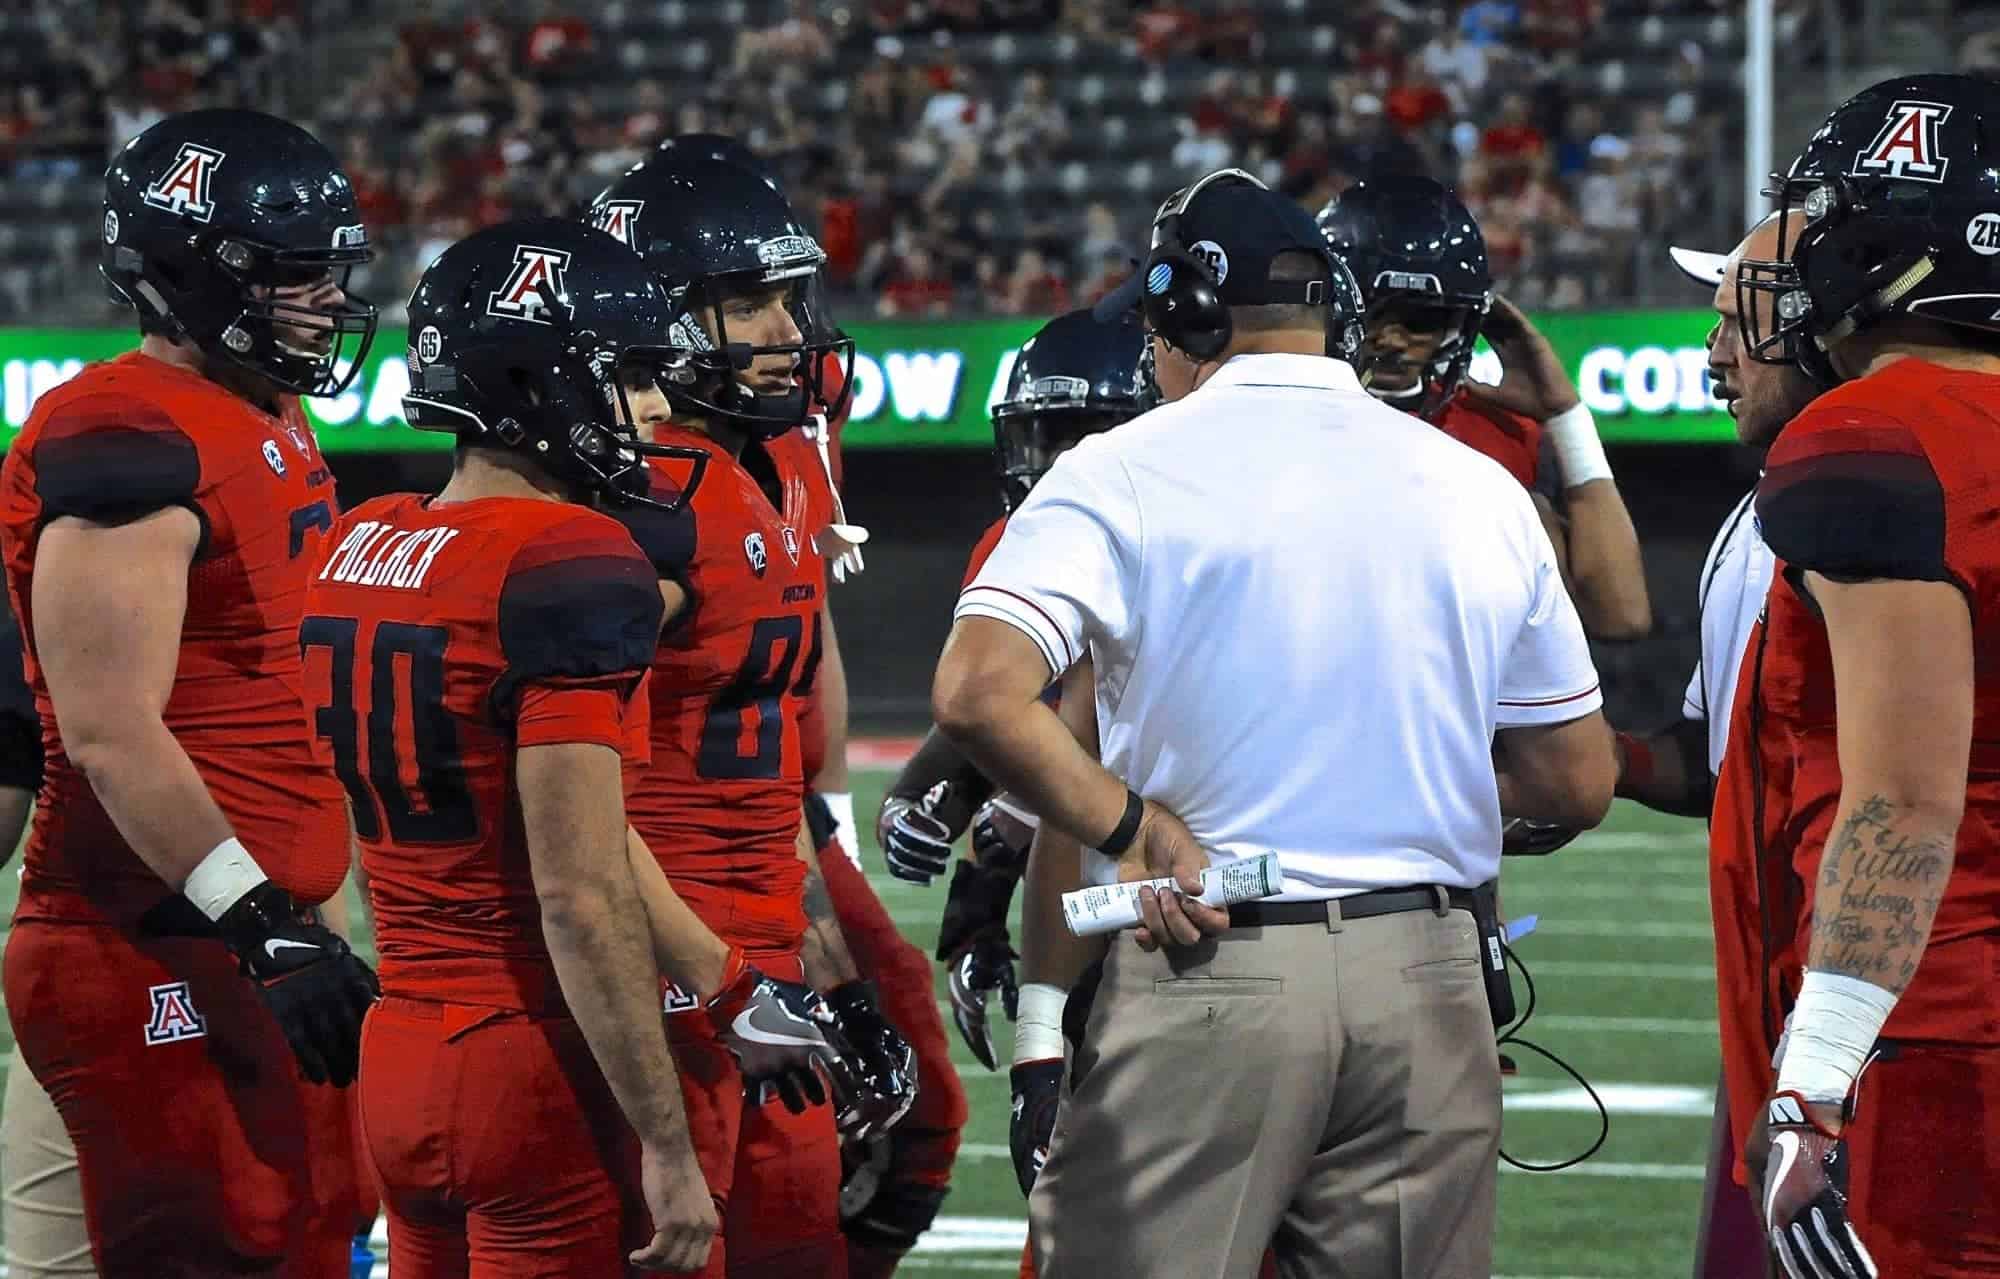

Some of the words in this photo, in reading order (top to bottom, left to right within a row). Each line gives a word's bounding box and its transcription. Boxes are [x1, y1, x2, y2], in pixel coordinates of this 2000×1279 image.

[143, 142, 226, 223] A
[1852, 100, 1953, 184] A
[486, 244, 575, 325] A
[421, 331, 437, 358] 65
[318, 521, 459, 589] POLLACK
[696, 608, 823, 779] 8
[144, 982, 208, 1046] A
